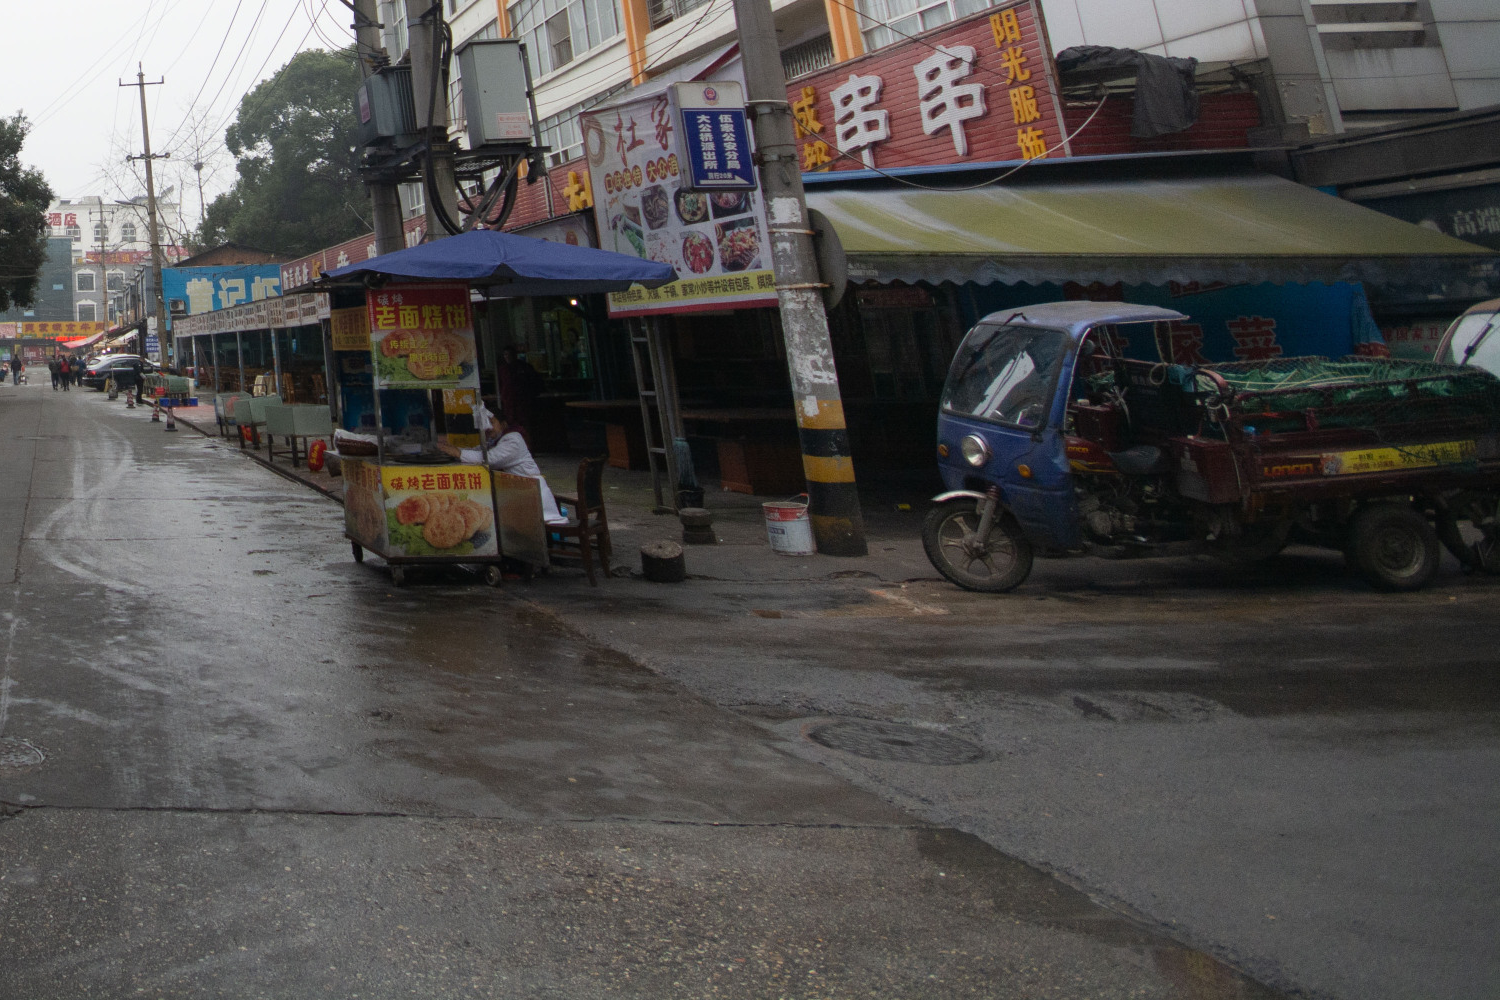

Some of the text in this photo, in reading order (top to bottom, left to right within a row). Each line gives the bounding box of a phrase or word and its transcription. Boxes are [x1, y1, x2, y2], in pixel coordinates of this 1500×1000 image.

[829, 44, 989, 171] 串串
[988, 8, 1048, 160] 阳光服饰
[696, 114, 718, 170] 大公桥派出所
[718, 114, 741, 170] 伍家公安分局
[604, 164, 643, 195] 口味独特
[375, 304, 467, 330] 老面烧饼
[390, 476, 420, 491] 碳烤
[421, 473, 483, 491] 老面烧饼
